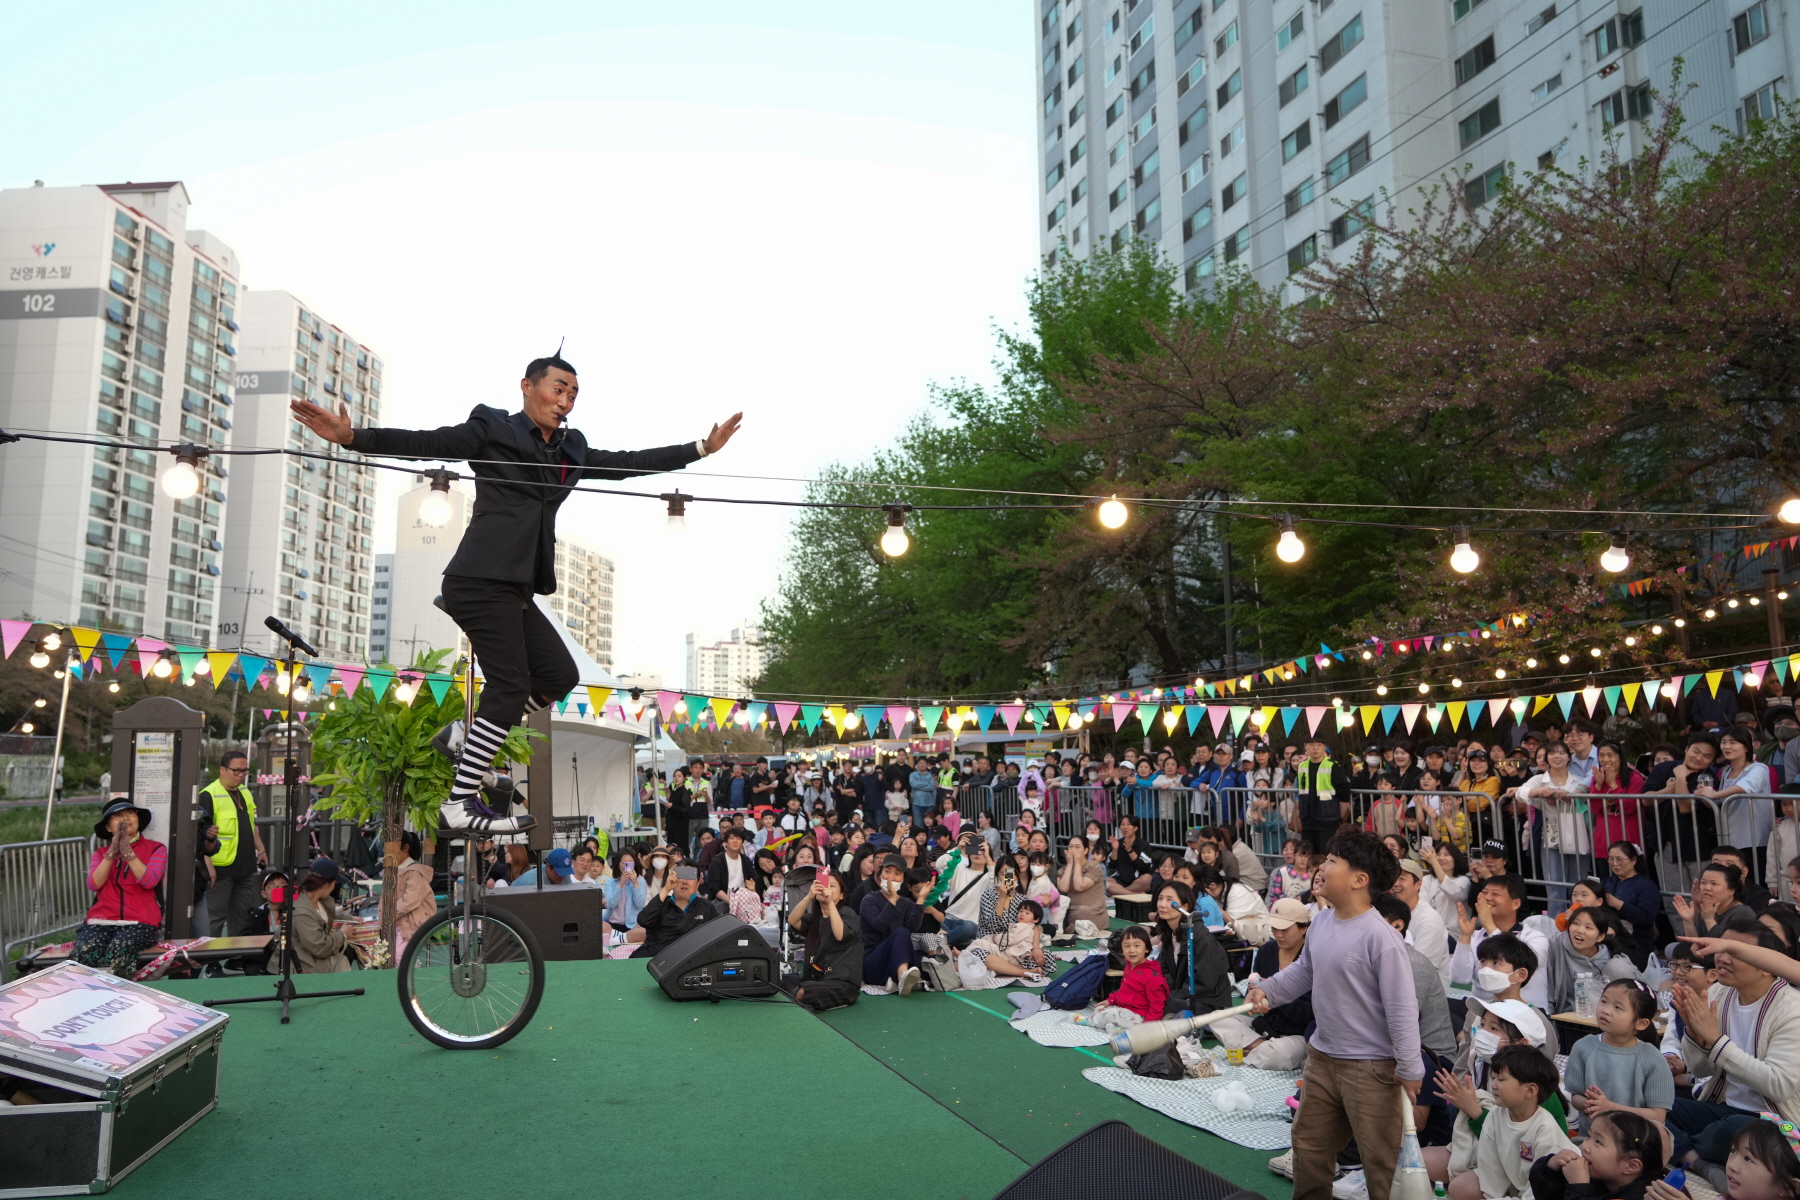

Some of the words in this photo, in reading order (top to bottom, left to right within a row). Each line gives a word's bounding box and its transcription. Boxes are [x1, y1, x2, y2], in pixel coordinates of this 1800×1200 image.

[10, 265, 72, 281] 건영캐스빌
[22, 294, 56, 313] 102
[235, 374, 259, 389] 103
[421, 535, 436, 545] 101
[218, 622, 239, 635] 103
